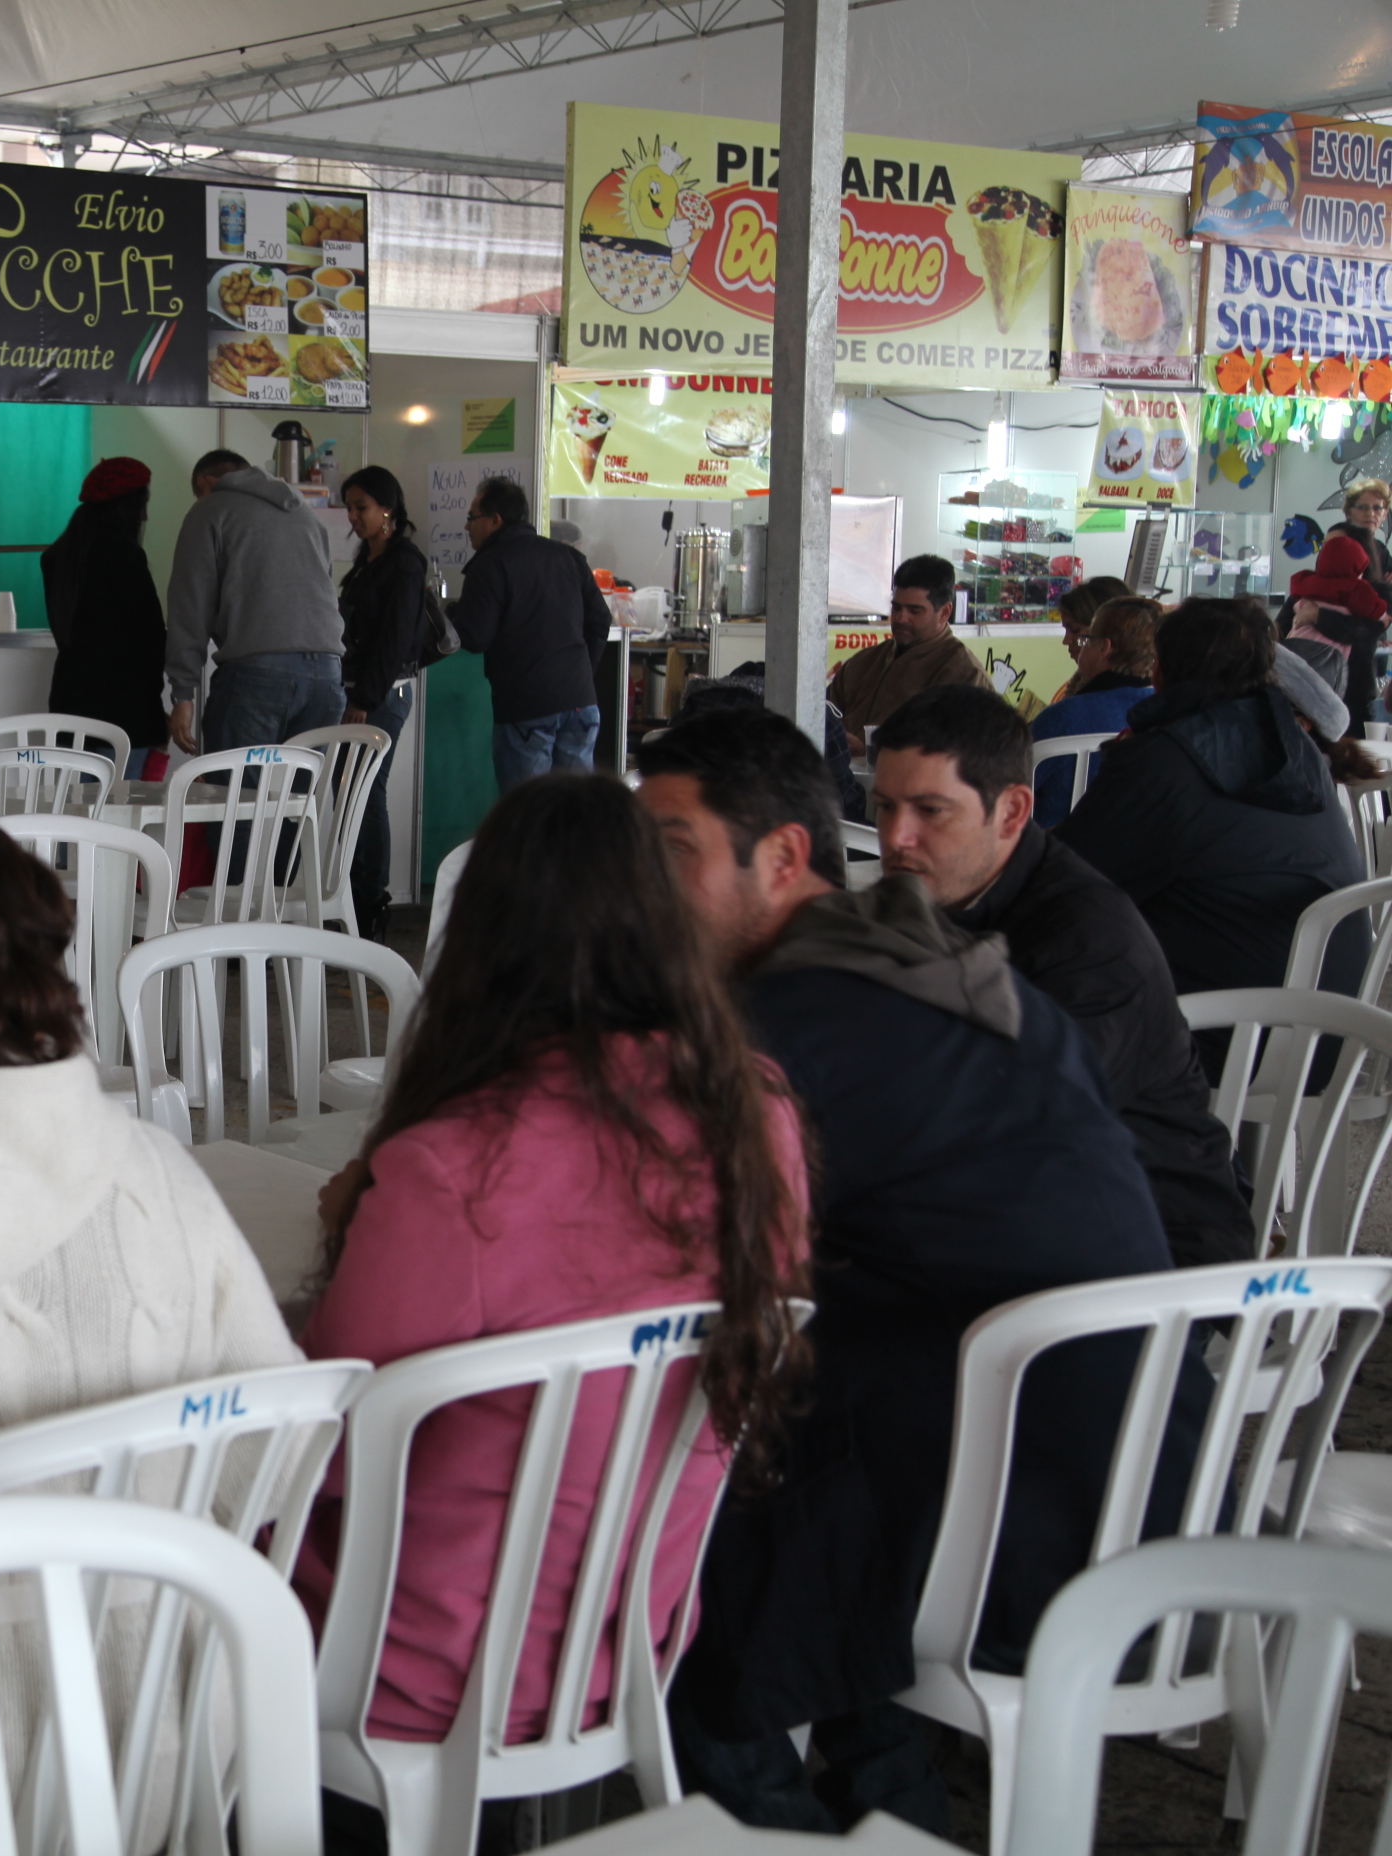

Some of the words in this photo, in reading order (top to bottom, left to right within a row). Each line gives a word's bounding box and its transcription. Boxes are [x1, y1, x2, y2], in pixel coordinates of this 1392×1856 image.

[1311, 128, 1392, 188] ESCOLA
[716, 141, 956, 206] PIARIA
[74, 190, 164, 233] Elvio
[1070, 205, 1189, 254] Panquecone
[1300, 195, 1386, 250] UNIDOS
[246, 250, 257, 260] R$
[326, 257, 337, 266] R$
[247, 321, 258, 331] R$
[580, 323, 627, 349] UM
[639, 326, 724, 354] NOVO
[876, 341, 976, 369] COMER
[984, 346, 1060, 372] PIZZA
[1117, 362, 1140, 375] Doce
[1147, 362, 1190, 378] Salgada
[249, 391, 260, 401] R$
[1114, 399, 1188, 419] TAPIOCA
[604, 455, 629, 468] CONE
[698, 459, 729, 472] BATATA
[603, 470, 649, 484] RECHEADO
[684, 473, 727, 487] RECHEADA
[1137, 487, 1143, 498] E
[1156, 487, 1175, 499] DOCE
[431, 523, 470, 549] Cervej
[835, 633, 879, 650] BOM
[17, 749, 46, 764] MIL
[245, 746, 283, 764] MIL
[1242, 1267, 1312, 1306] MIL
[179, 1384, 248, 1428] MIL
